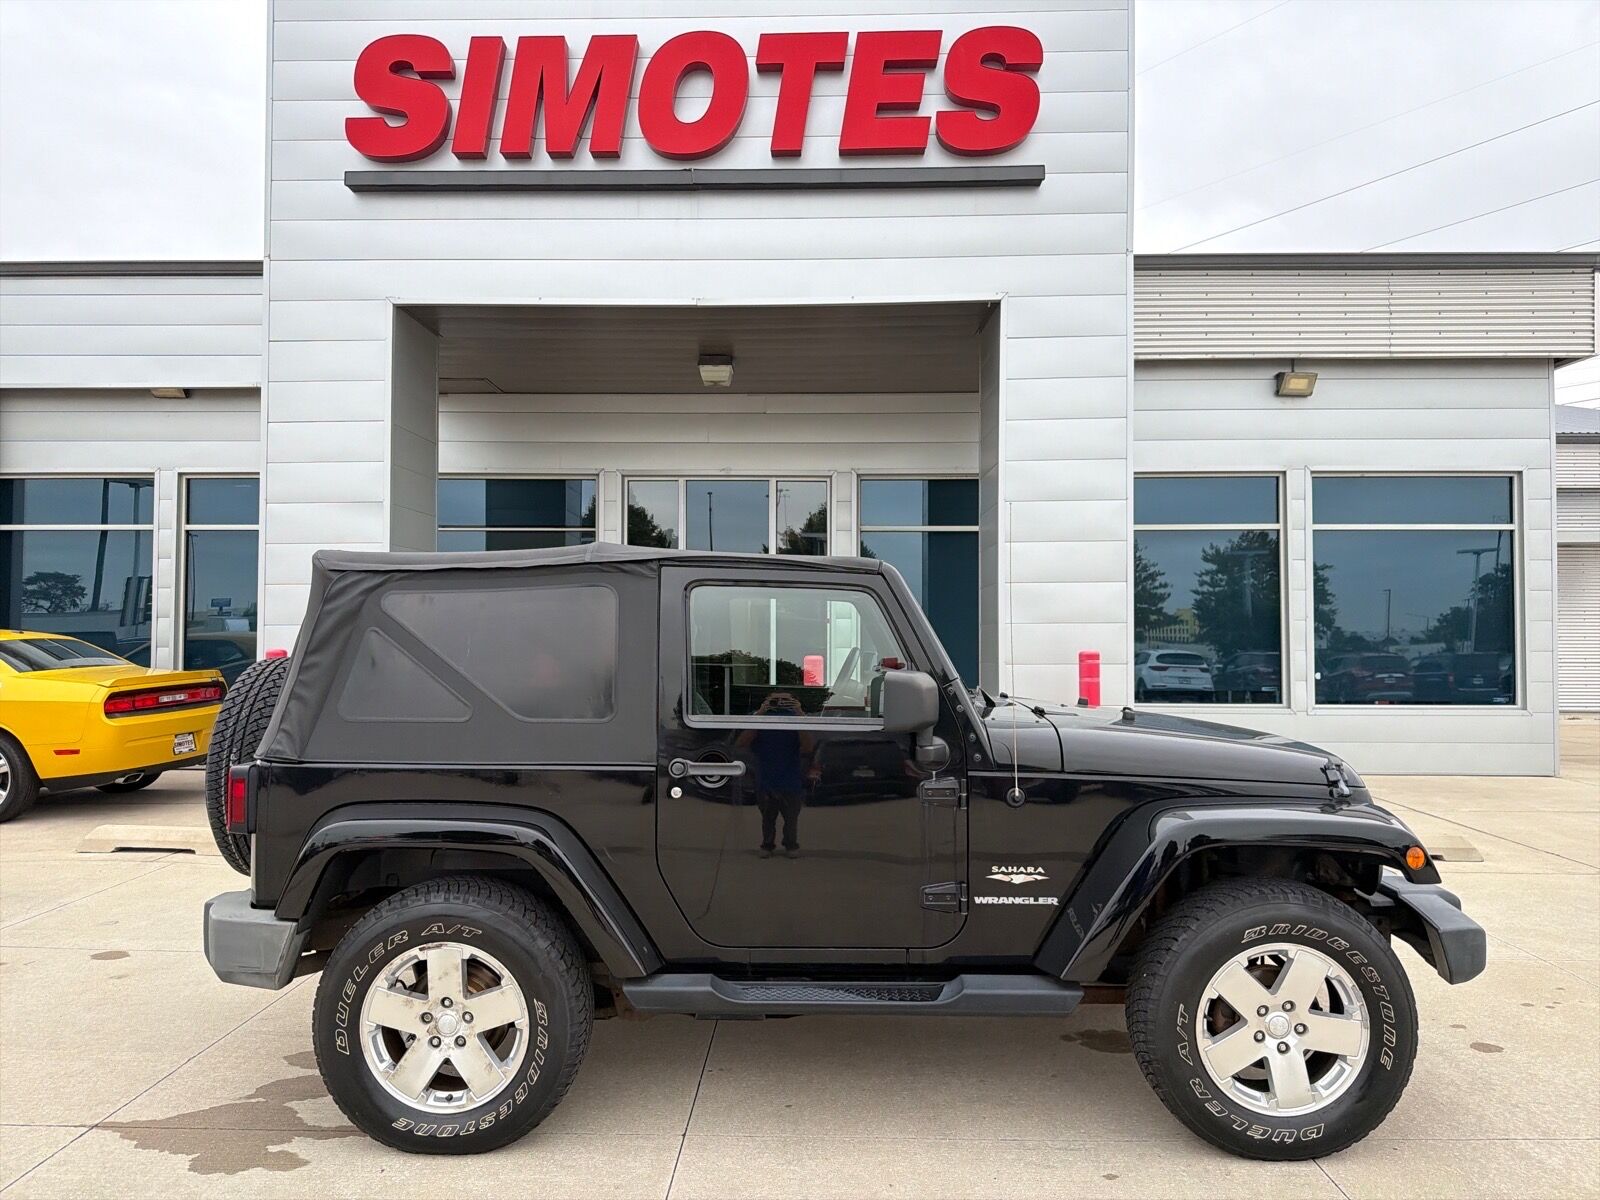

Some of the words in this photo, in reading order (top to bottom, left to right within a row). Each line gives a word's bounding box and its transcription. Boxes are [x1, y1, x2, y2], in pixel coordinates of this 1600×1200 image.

[345, 25, 1044, 163] SIMOTES
[974, 896, 1059, 906] WRANGLER
[991, 865, 1045, 873] SAHARA
[335, 930, 409, 1056] DUELER
[421, 922, 482, 938] A/T
[1177, 1003, 1194, 1066] A/T
[1241, 923, 1396, 1071] BRIDGESTONE
[392, 998, 549, 1138] BRIDGESTONE
[1189, 1078, 1325, 1144] DUELER
